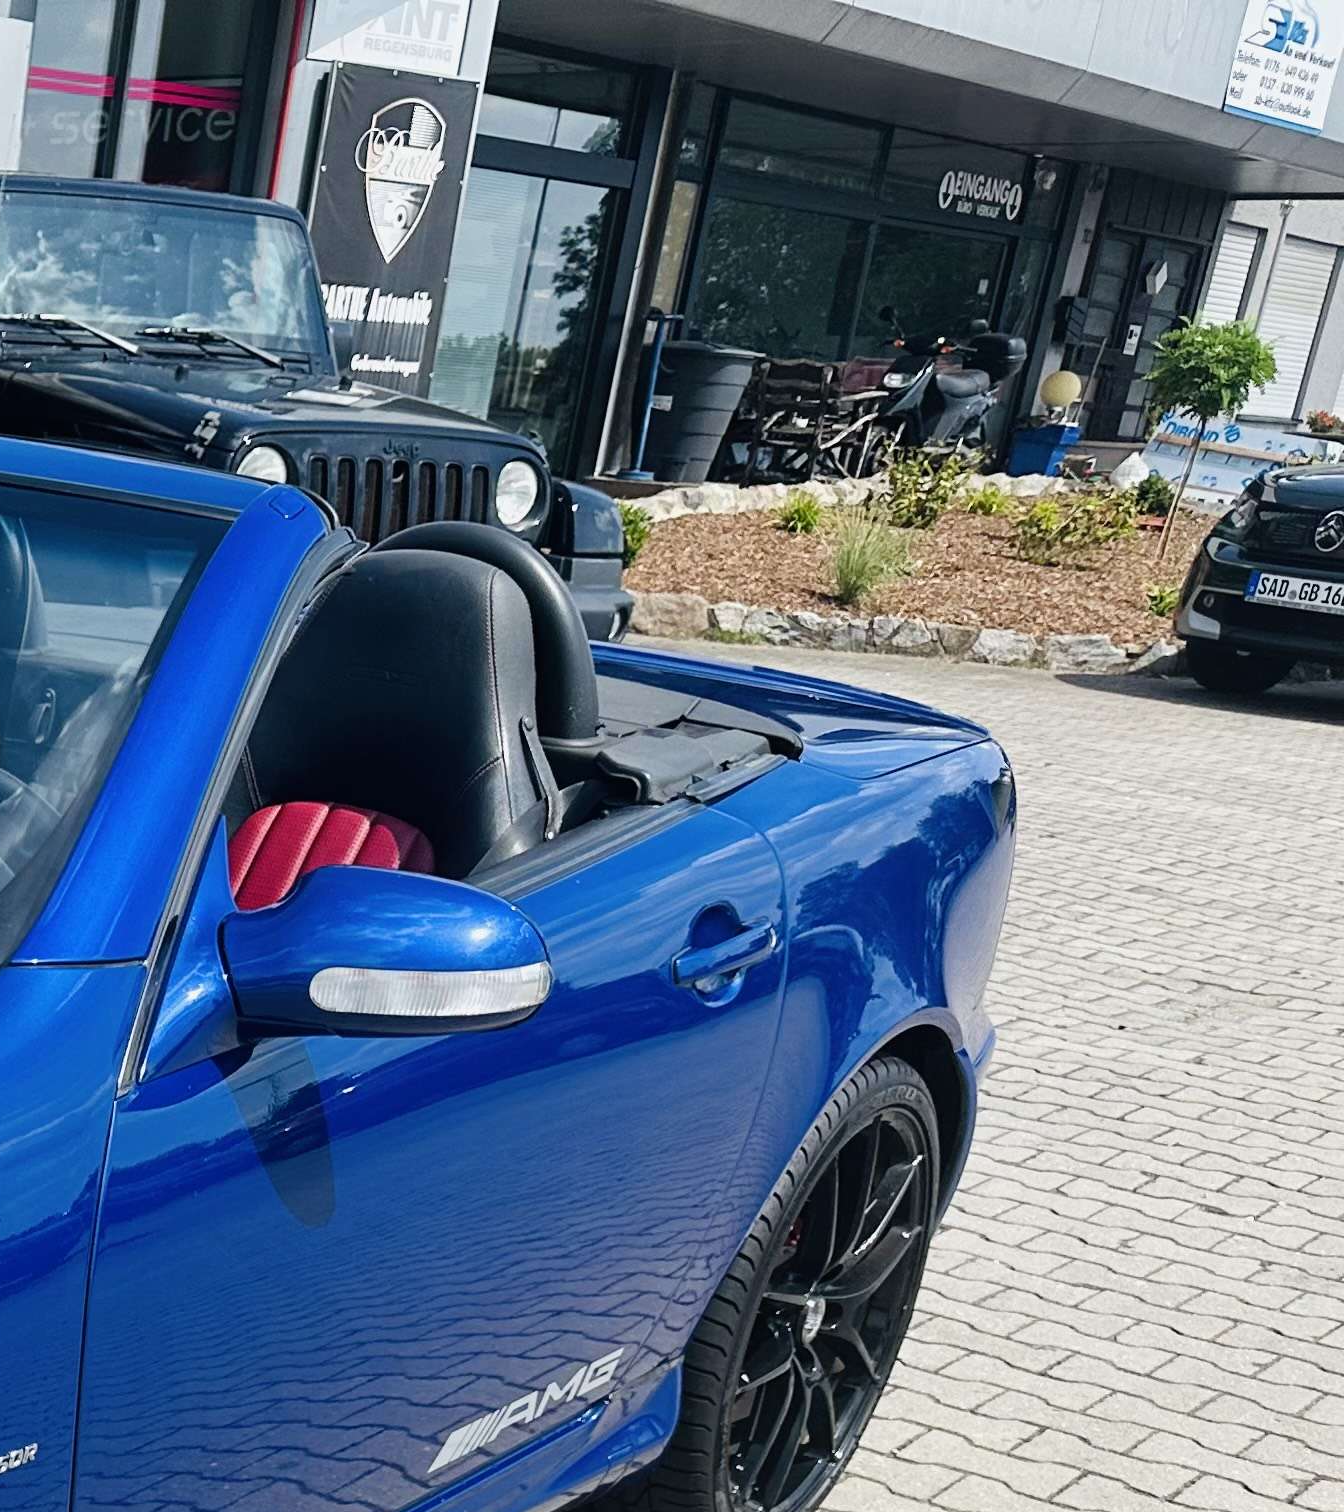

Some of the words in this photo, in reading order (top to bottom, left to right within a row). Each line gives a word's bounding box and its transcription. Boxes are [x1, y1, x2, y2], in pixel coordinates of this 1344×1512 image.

[363, 37, 453, 63] REGENSBURG
[1309, 51, 1337, 69] Verkauf
[954, 171, 1011, 204] EINGANG
[1258, 577, 1289, 598] SAD
[1298, 582, 1321, 602] GB
[1321, 586, 1344, 607] 16
[487, 1347, 624, 1443] AMG
